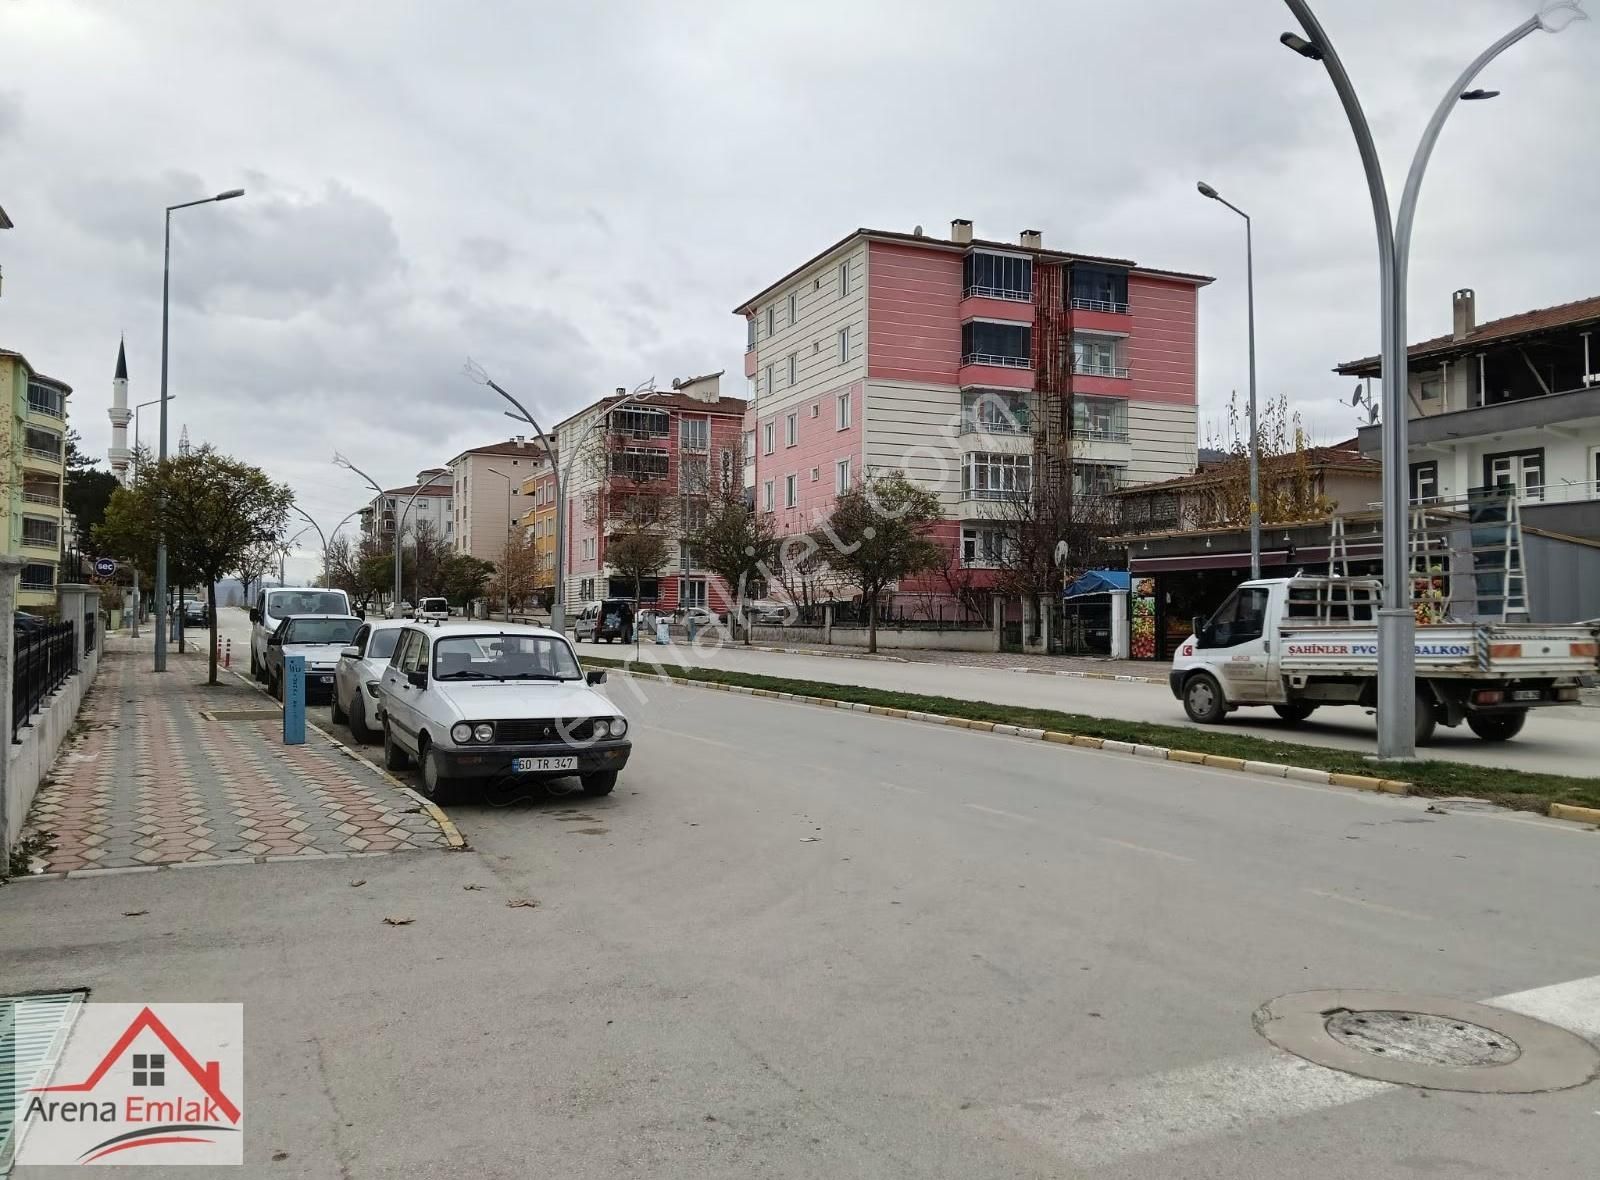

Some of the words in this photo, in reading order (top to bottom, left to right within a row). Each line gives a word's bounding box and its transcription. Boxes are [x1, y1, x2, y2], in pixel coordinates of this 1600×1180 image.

[1288, 643, 1348, 656] ŞAHİNLER
[1352, 645, 1377, 655] PVC
[519, 759, 532, 770] 60
[537, 759, 550, 769] TR
[554, 757, 573, 769] 347
